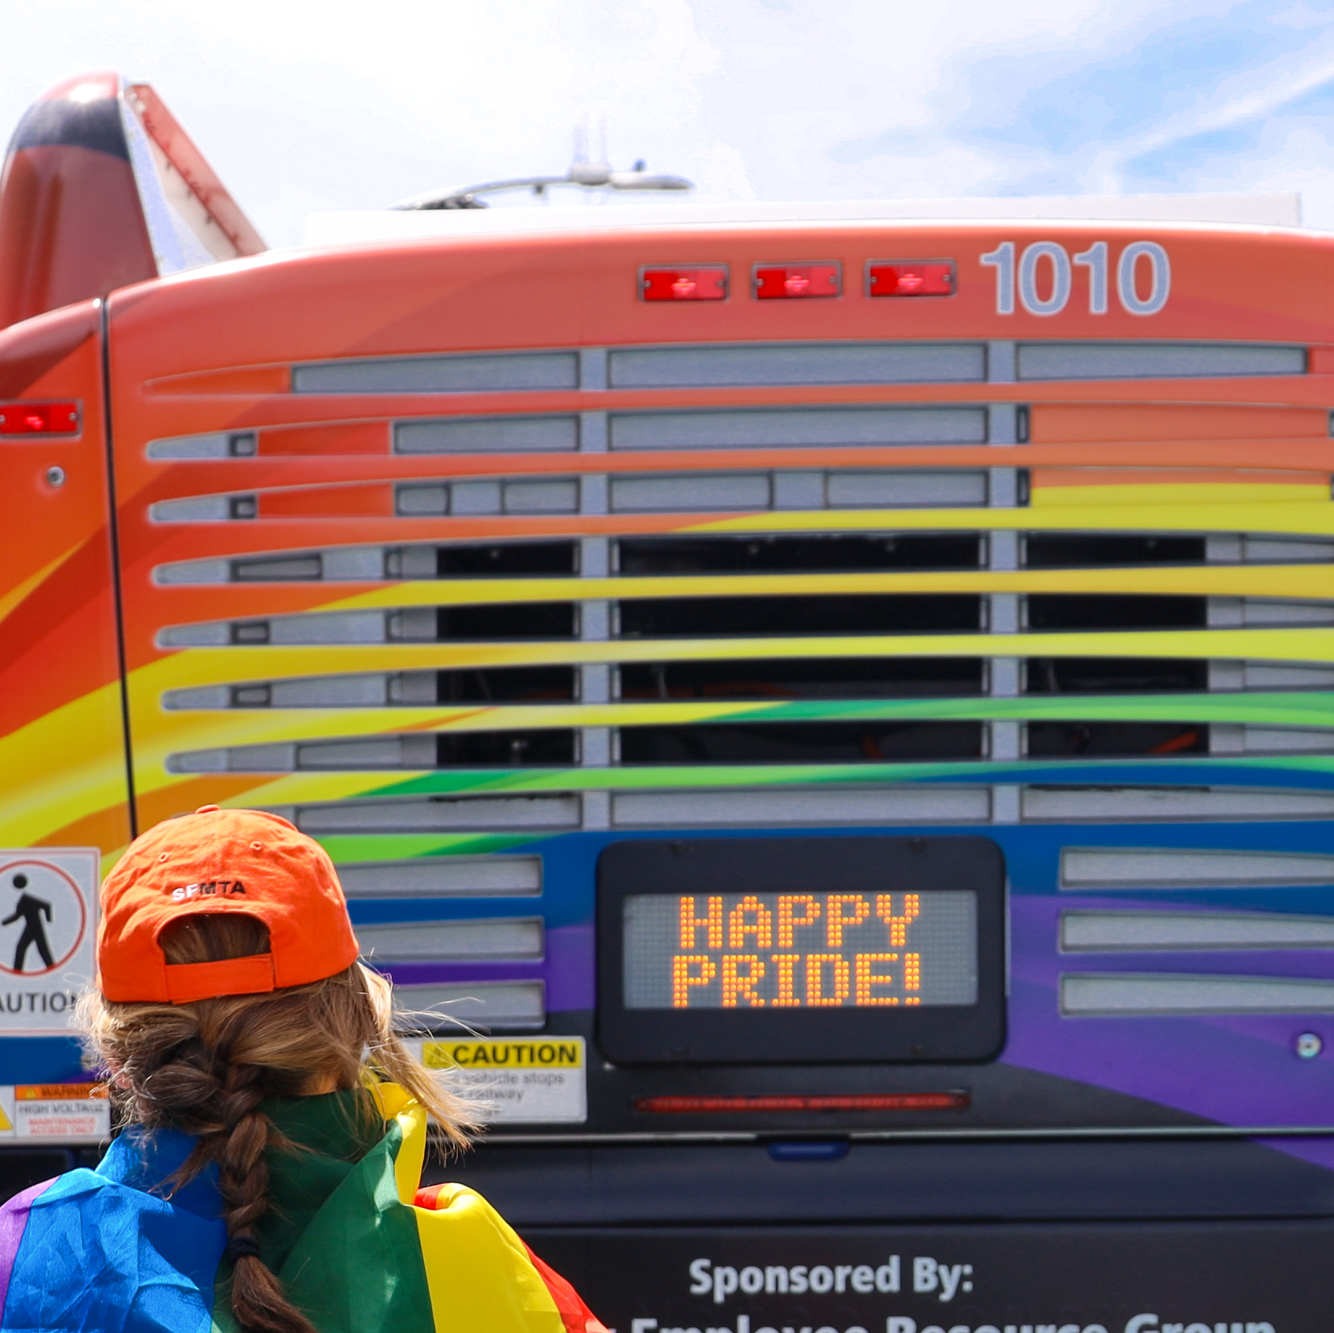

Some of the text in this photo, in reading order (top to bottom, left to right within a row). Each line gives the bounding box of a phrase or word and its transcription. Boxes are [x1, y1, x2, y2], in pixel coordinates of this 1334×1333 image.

[979, 240, 1172, 317] 1010
[172, 880, 246, 901] SFMTA
[679, 894, 920, 948] HAPPY
[672, 952, 921, 1008] PRIDE!
[453, 1044, 577, 1065] CAUTION
[524, 1071, 565, 1086] stops
[19, 1103, 50, 1114] HIGH
[688, 1254, 973, 1303] Sponsored By:
